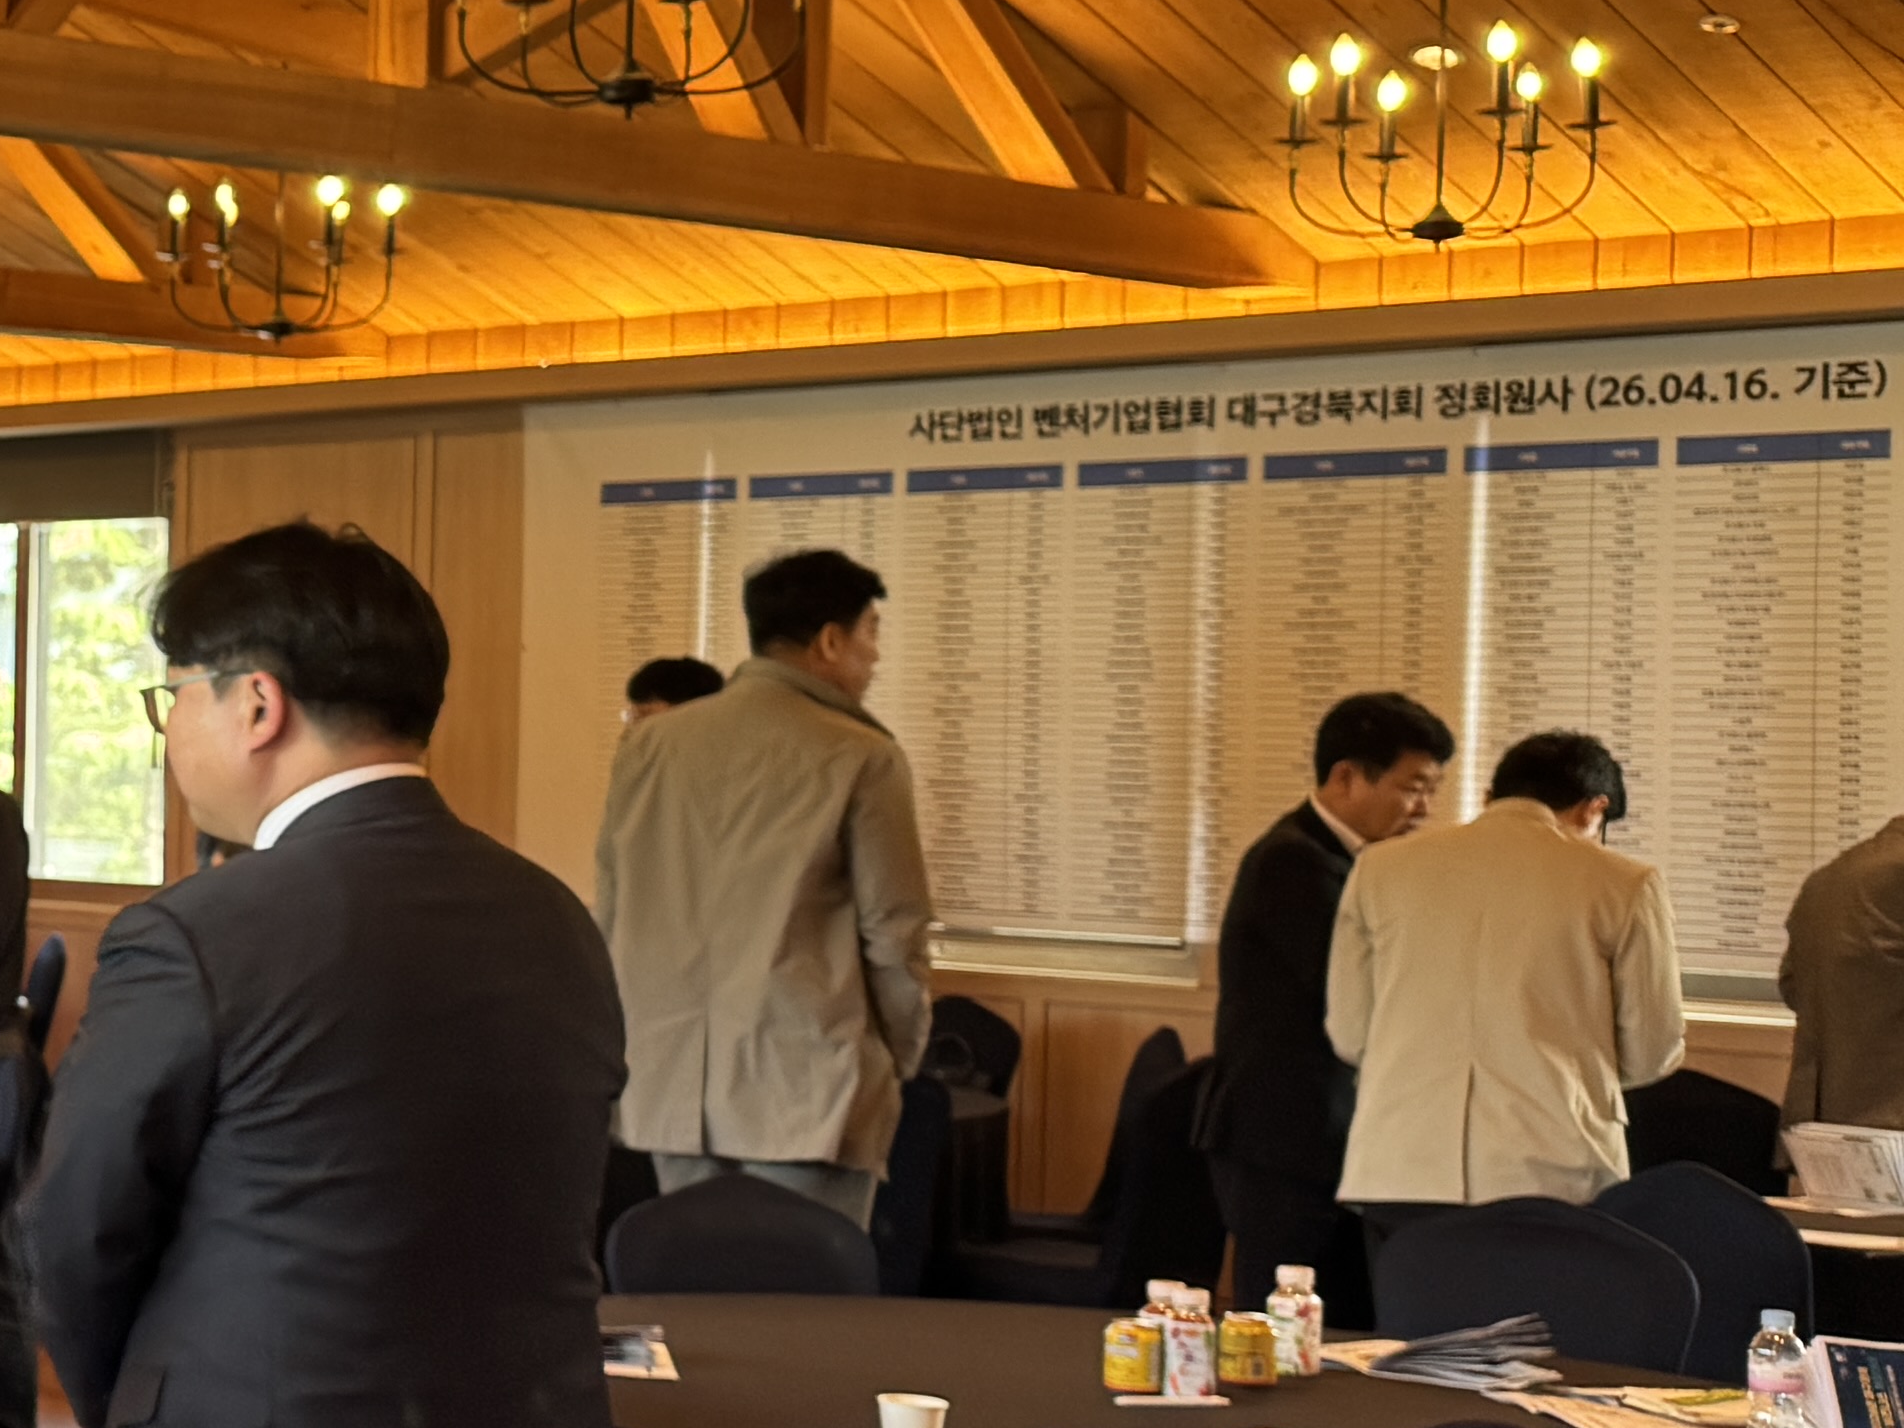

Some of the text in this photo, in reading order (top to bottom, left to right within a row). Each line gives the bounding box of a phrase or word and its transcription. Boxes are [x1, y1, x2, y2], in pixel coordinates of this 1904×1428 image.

[908, 360, 1887, 443] 사단법인 벤처기업협회 대구경북지회 정회원사 (26.04.16. 기준)
